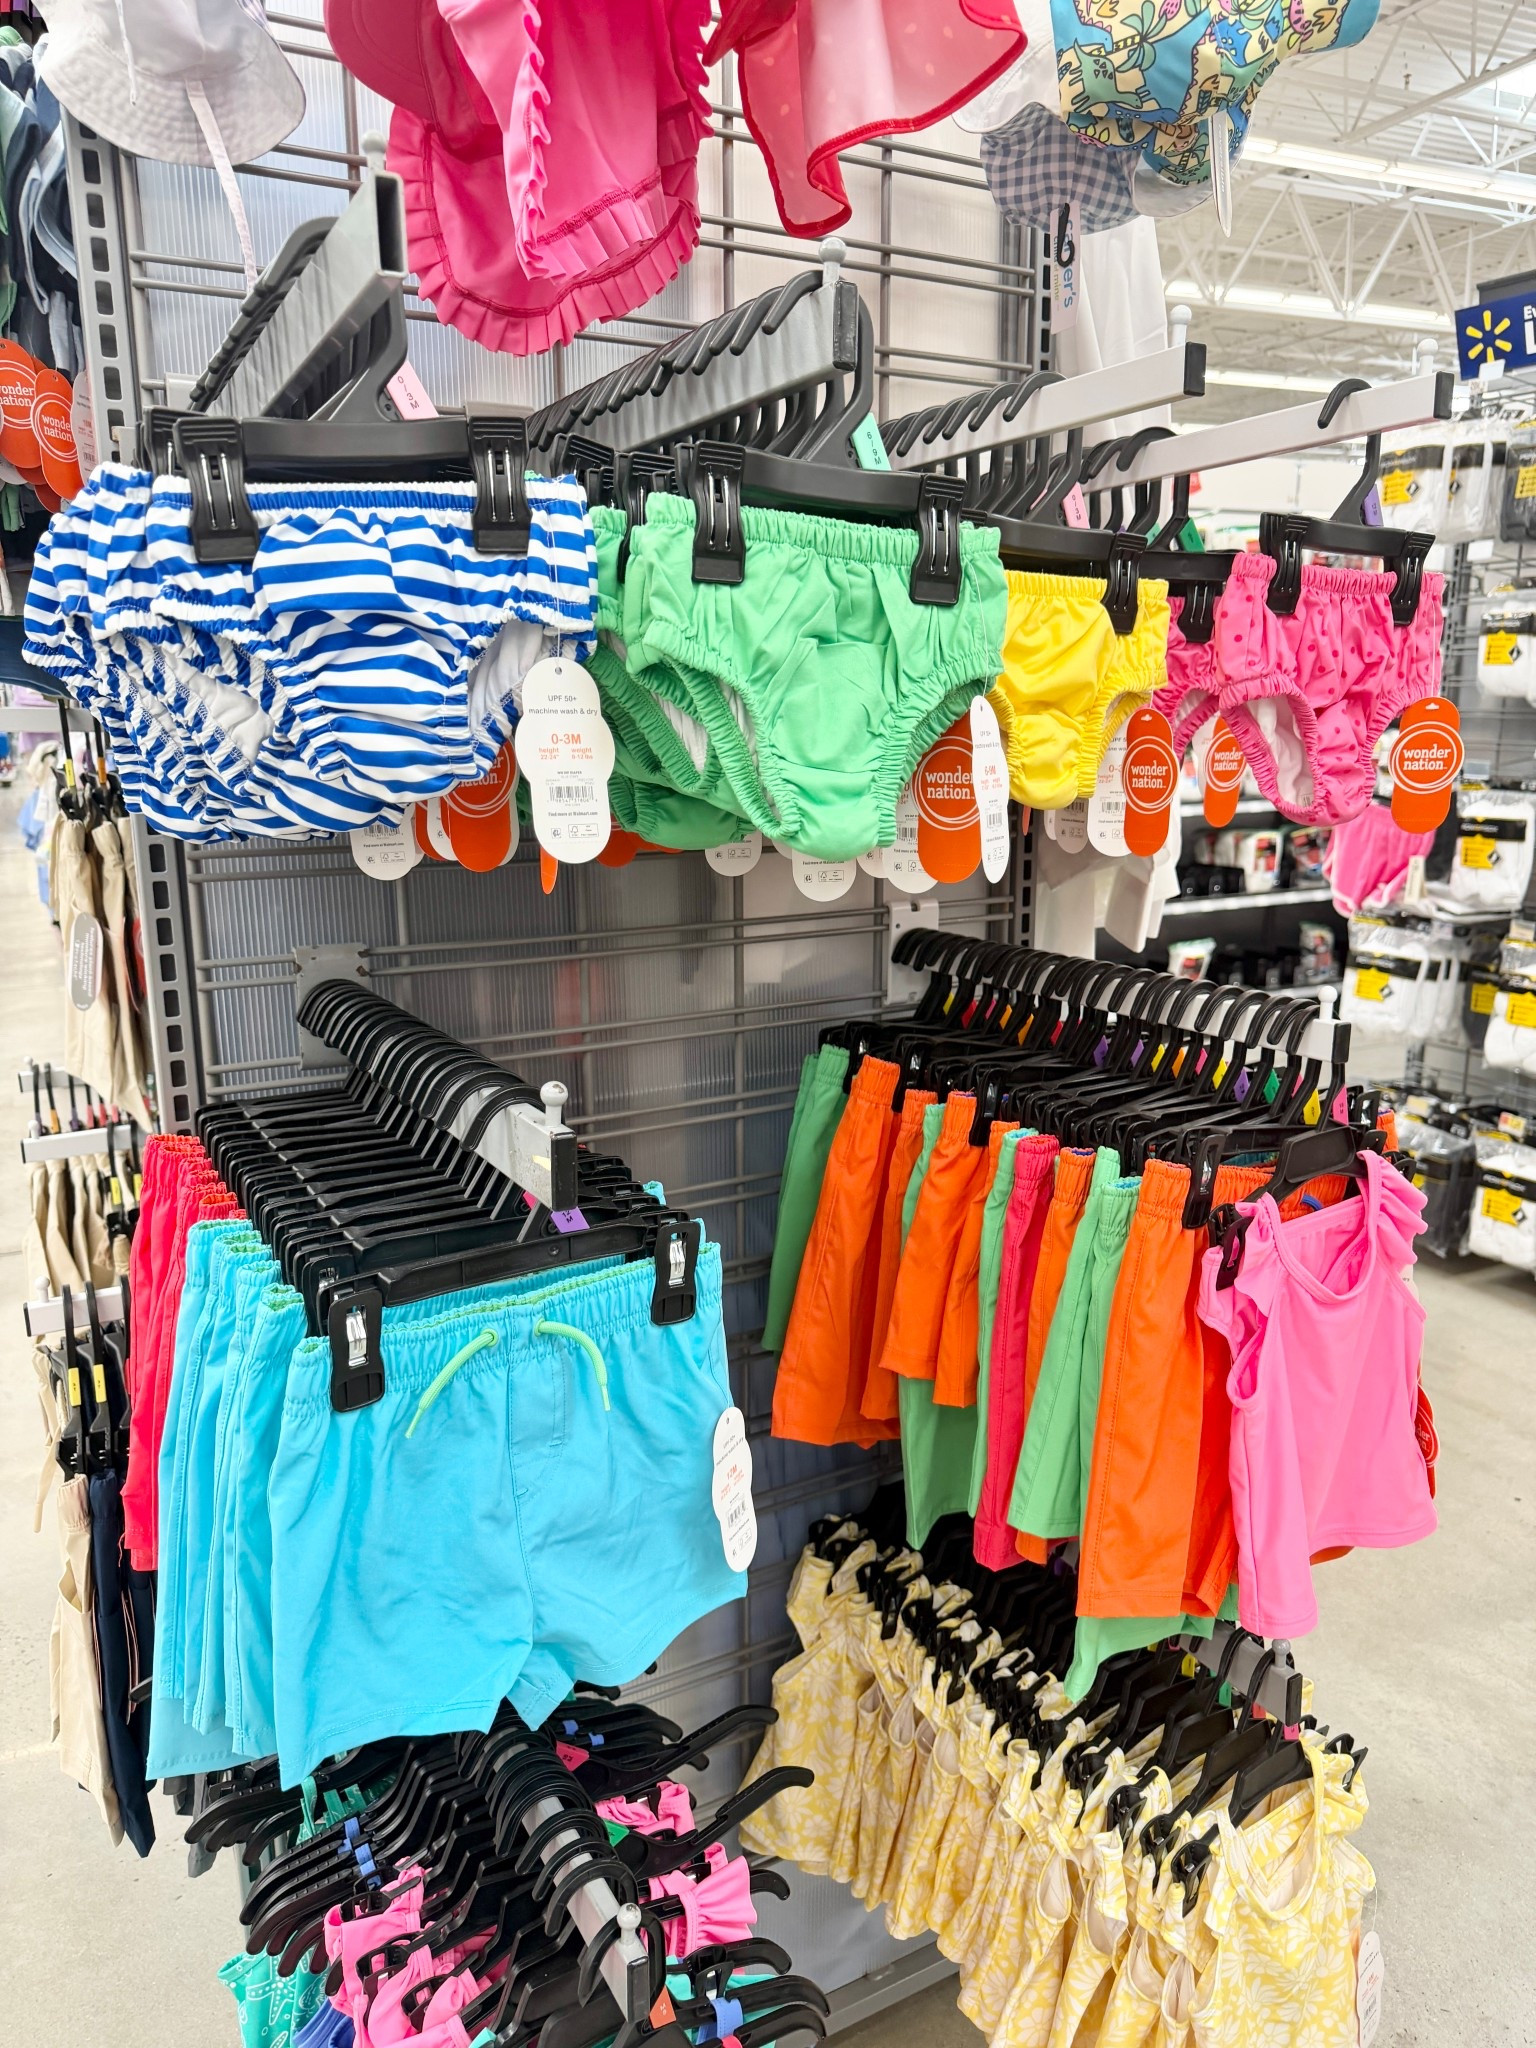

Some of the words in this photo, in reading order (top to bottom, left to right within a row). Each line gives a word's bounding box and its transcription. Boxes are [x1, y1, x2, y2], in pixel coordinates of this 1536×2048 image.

[397, 375, 420, 410] 0-3M
[42, 414, 72, 432] wonde
[867, 431, 882, 466] 6-9M
[548, 694, 562, 702] UPF
[528, 707, 559, 715] machine
[586, 708, 598, 716] dry
[551, 733, 581, 744] 0-3M
[1214, 747, 1243, 761] wonder
[1403, 744, 1452, 759] wonder
[1131, 760, 1168, 776] wonder
[1213, 760, 1238, 771] nation
[1403, 759, 1444, 771] nation
[1132, 776, 1163, 789] nation
[926, 784, 971, 799] nation
